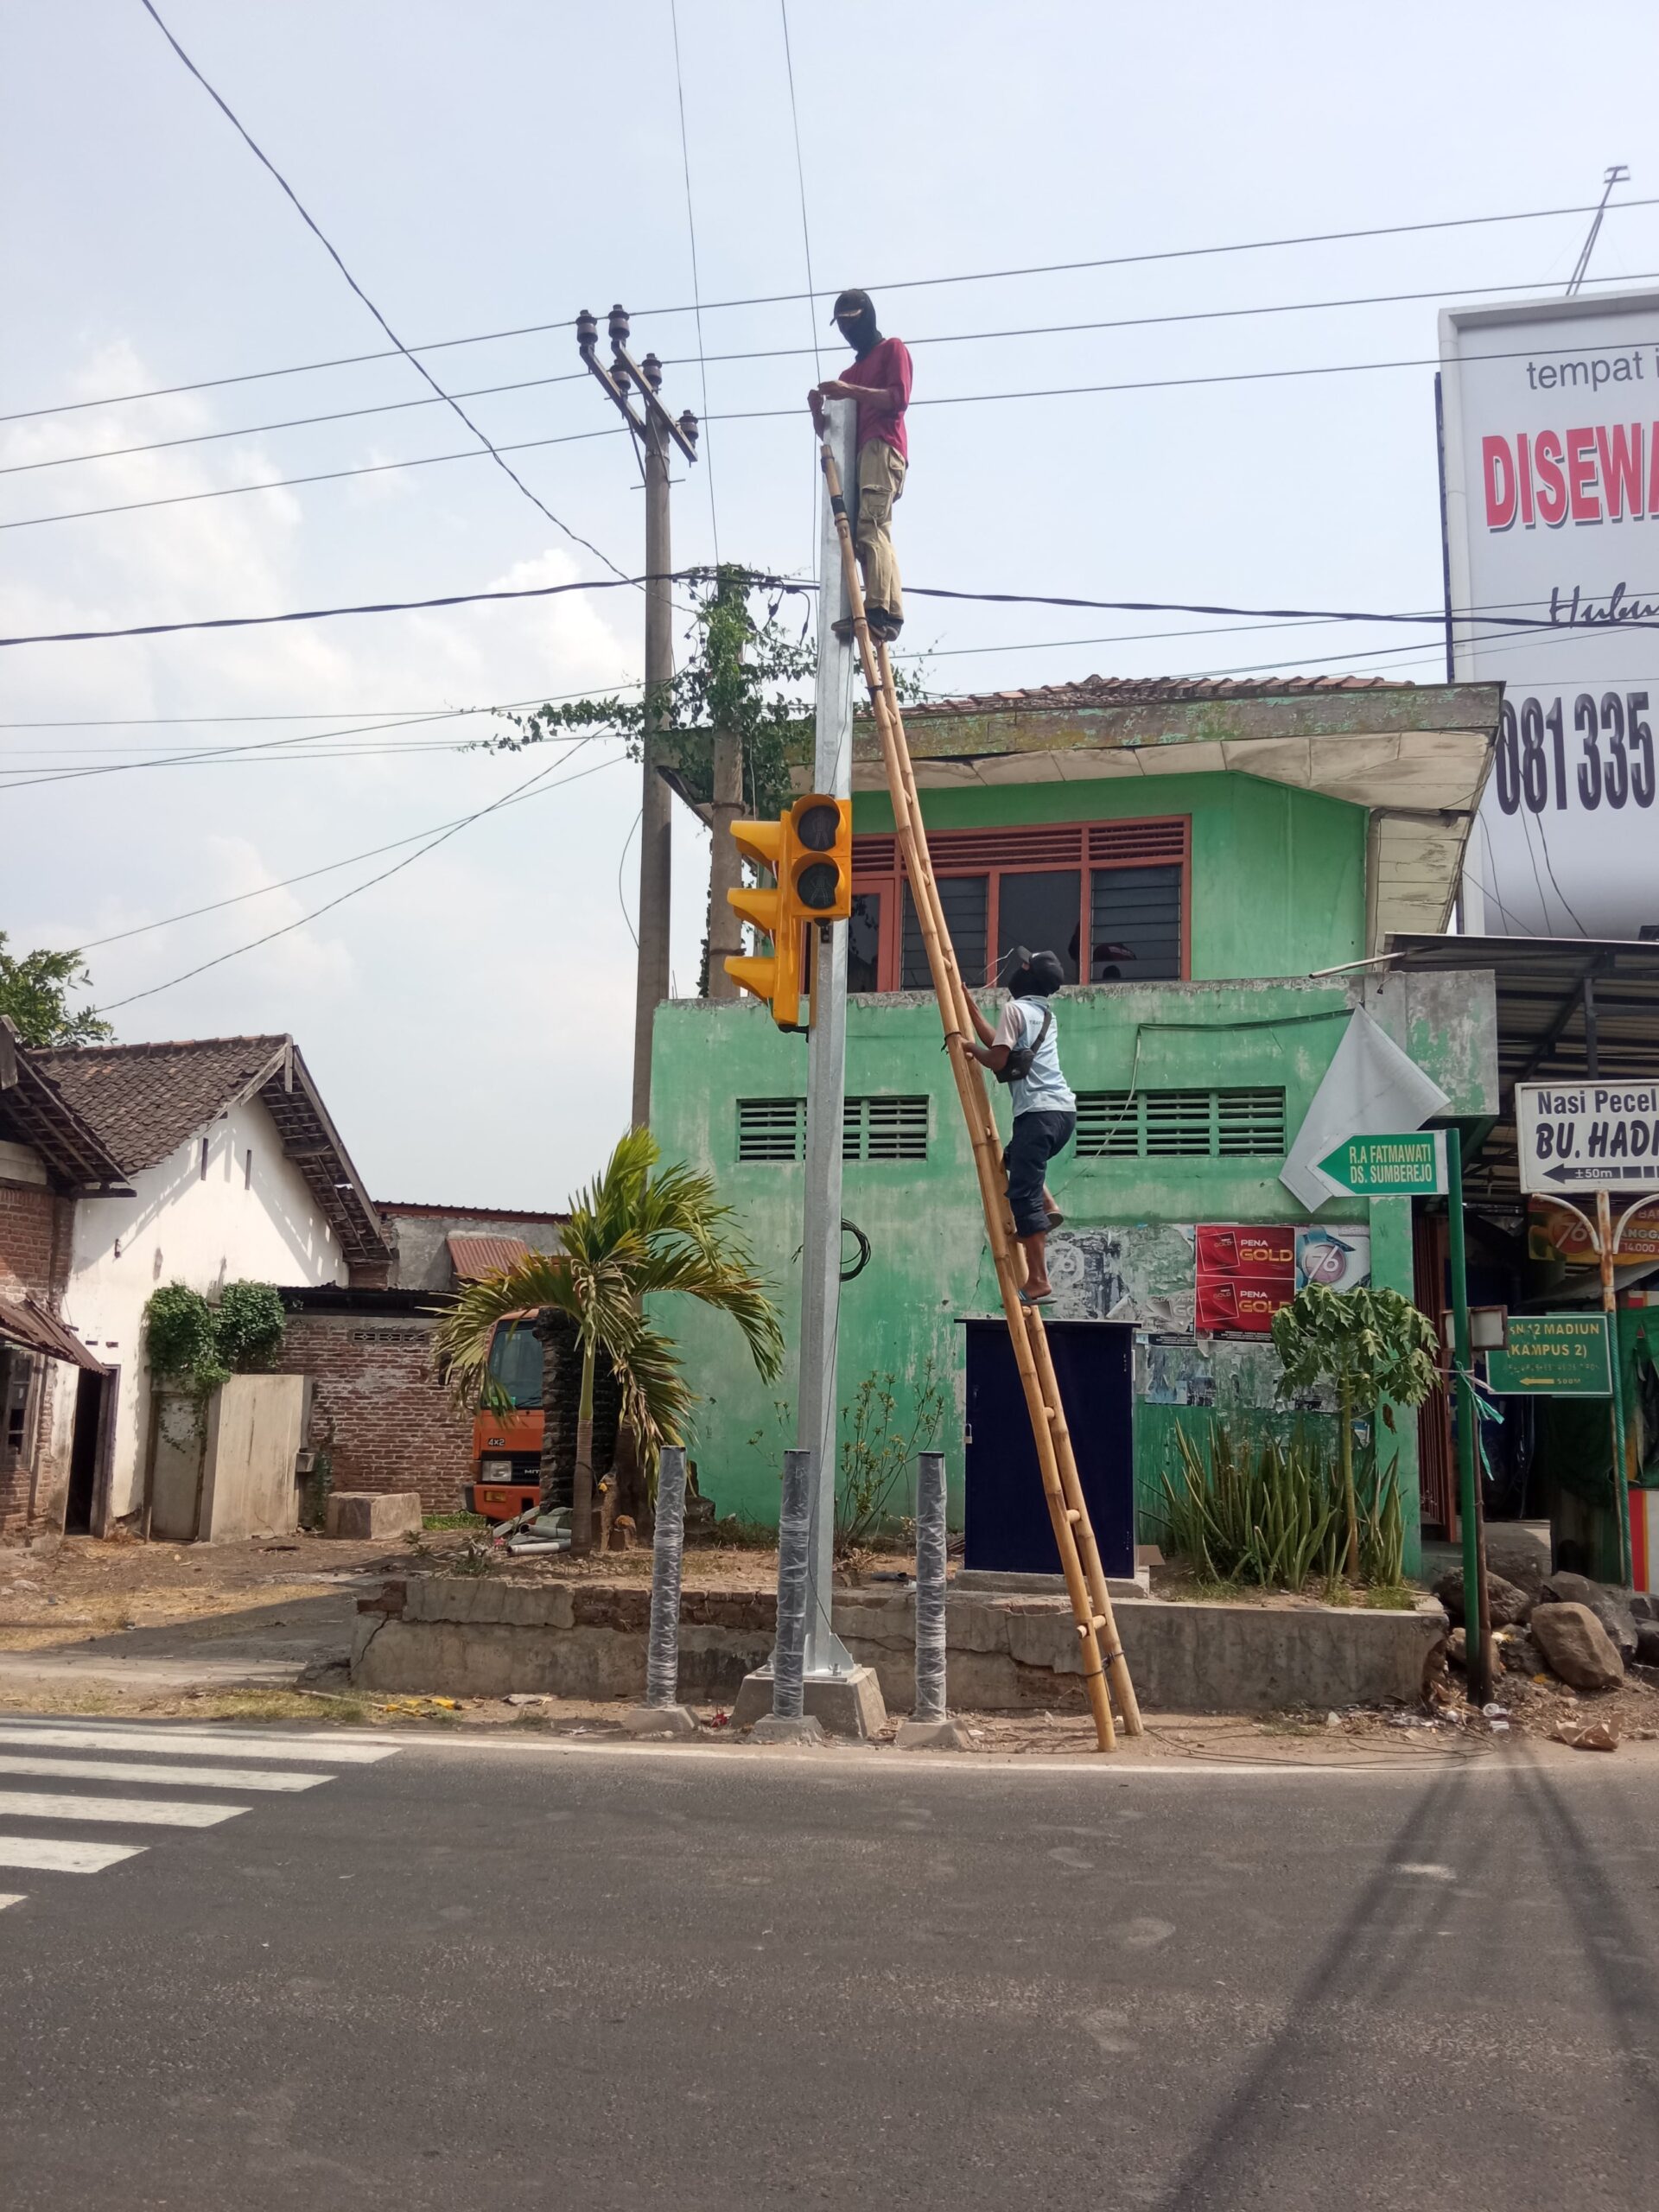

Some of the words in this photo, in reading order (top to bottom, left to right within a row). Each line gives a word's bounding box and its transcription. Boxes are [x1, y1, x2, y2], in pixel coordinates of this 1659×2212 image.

[1526, 351, 1644, 391] tempat
[1495, 691, 1656, 816] 081335
[1537, 1090, 1586, 1115] Nasi
[1594, 1088, 1657, 1113] Pecel
[1535, 1122, 1581, 1160] BU.
[1349, 1146, 1367, 1164] R.A
[1370, 1143, 1431, 1163] FATMAWATI
[1351, 1166, 1368, 1184] DS.
[1370, 1164, 1432, 1183] SUMBEREJO
[1240, 1249, 1294, 1262] GOLD
[1544, 1323, 1599, 1335] MADIUN
[1507, 1344, 1570, 1358] (KAMPUS
[1574, 1344, 1587, 1358] 2)
